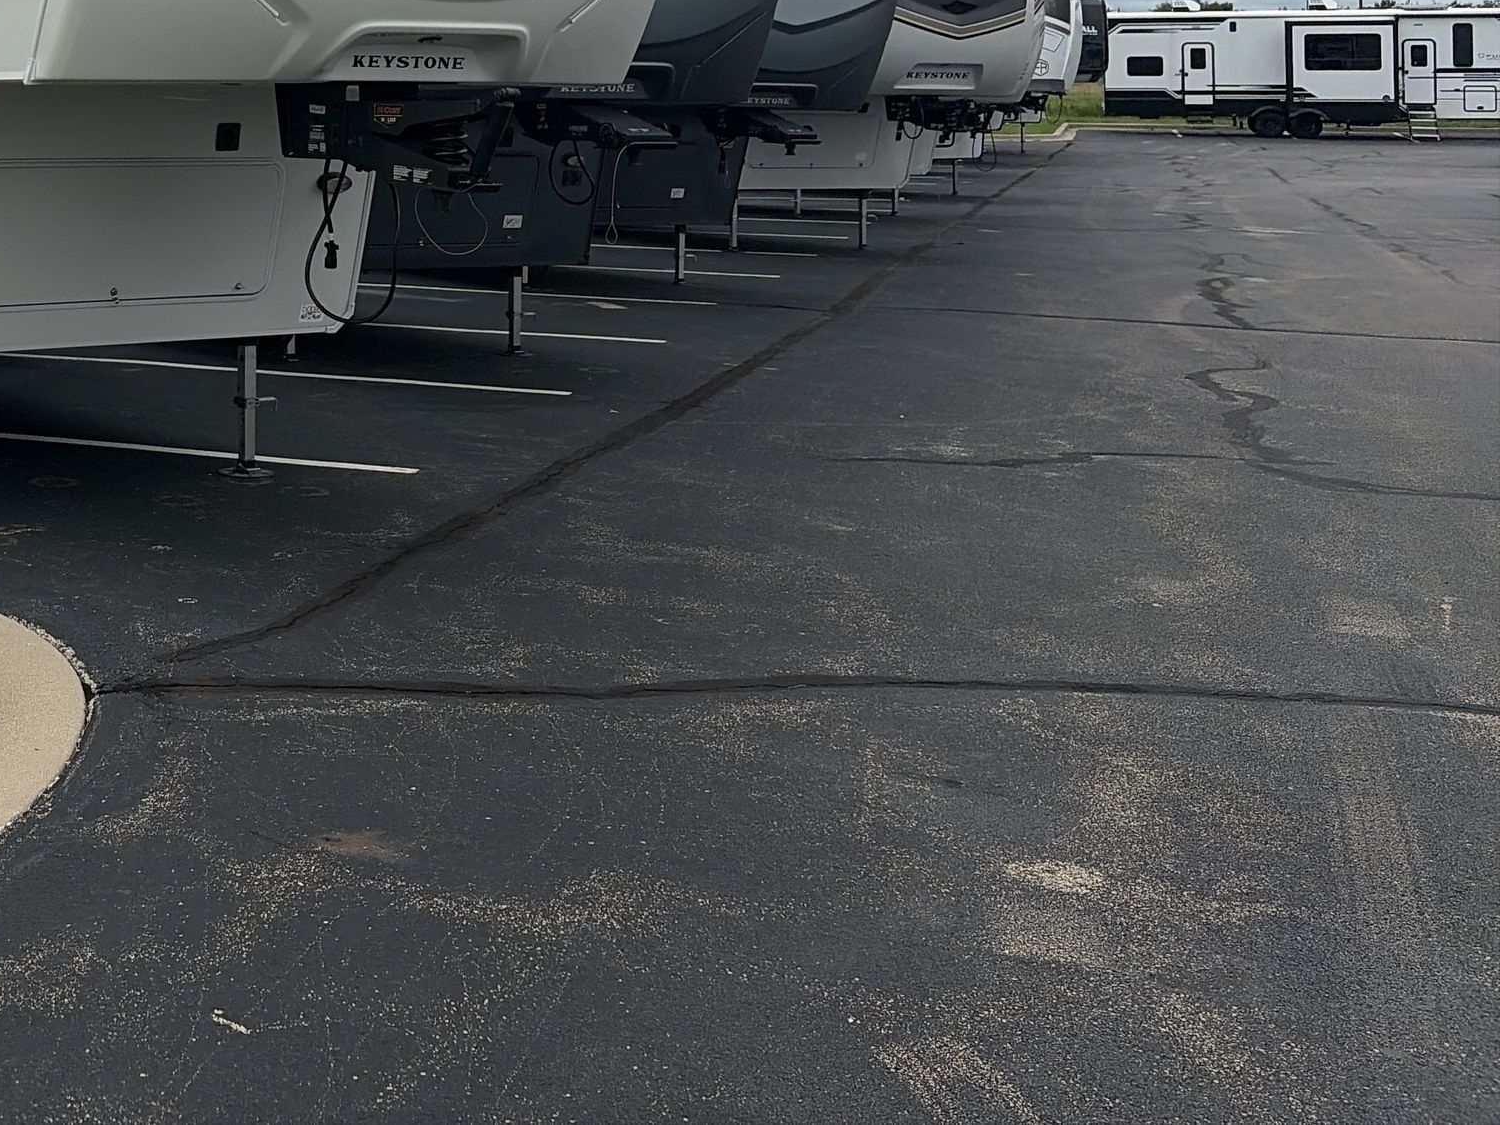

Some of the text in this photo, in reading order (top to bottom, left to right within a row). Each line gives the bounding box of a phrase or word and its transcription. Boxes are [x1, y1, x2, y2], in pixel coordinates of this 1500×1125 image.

[351, 55, 466, 70] KEYSTONE
[905, 71, 971, 79] KEYSTONE
[741, 97, 790, 105] EYSTONE
